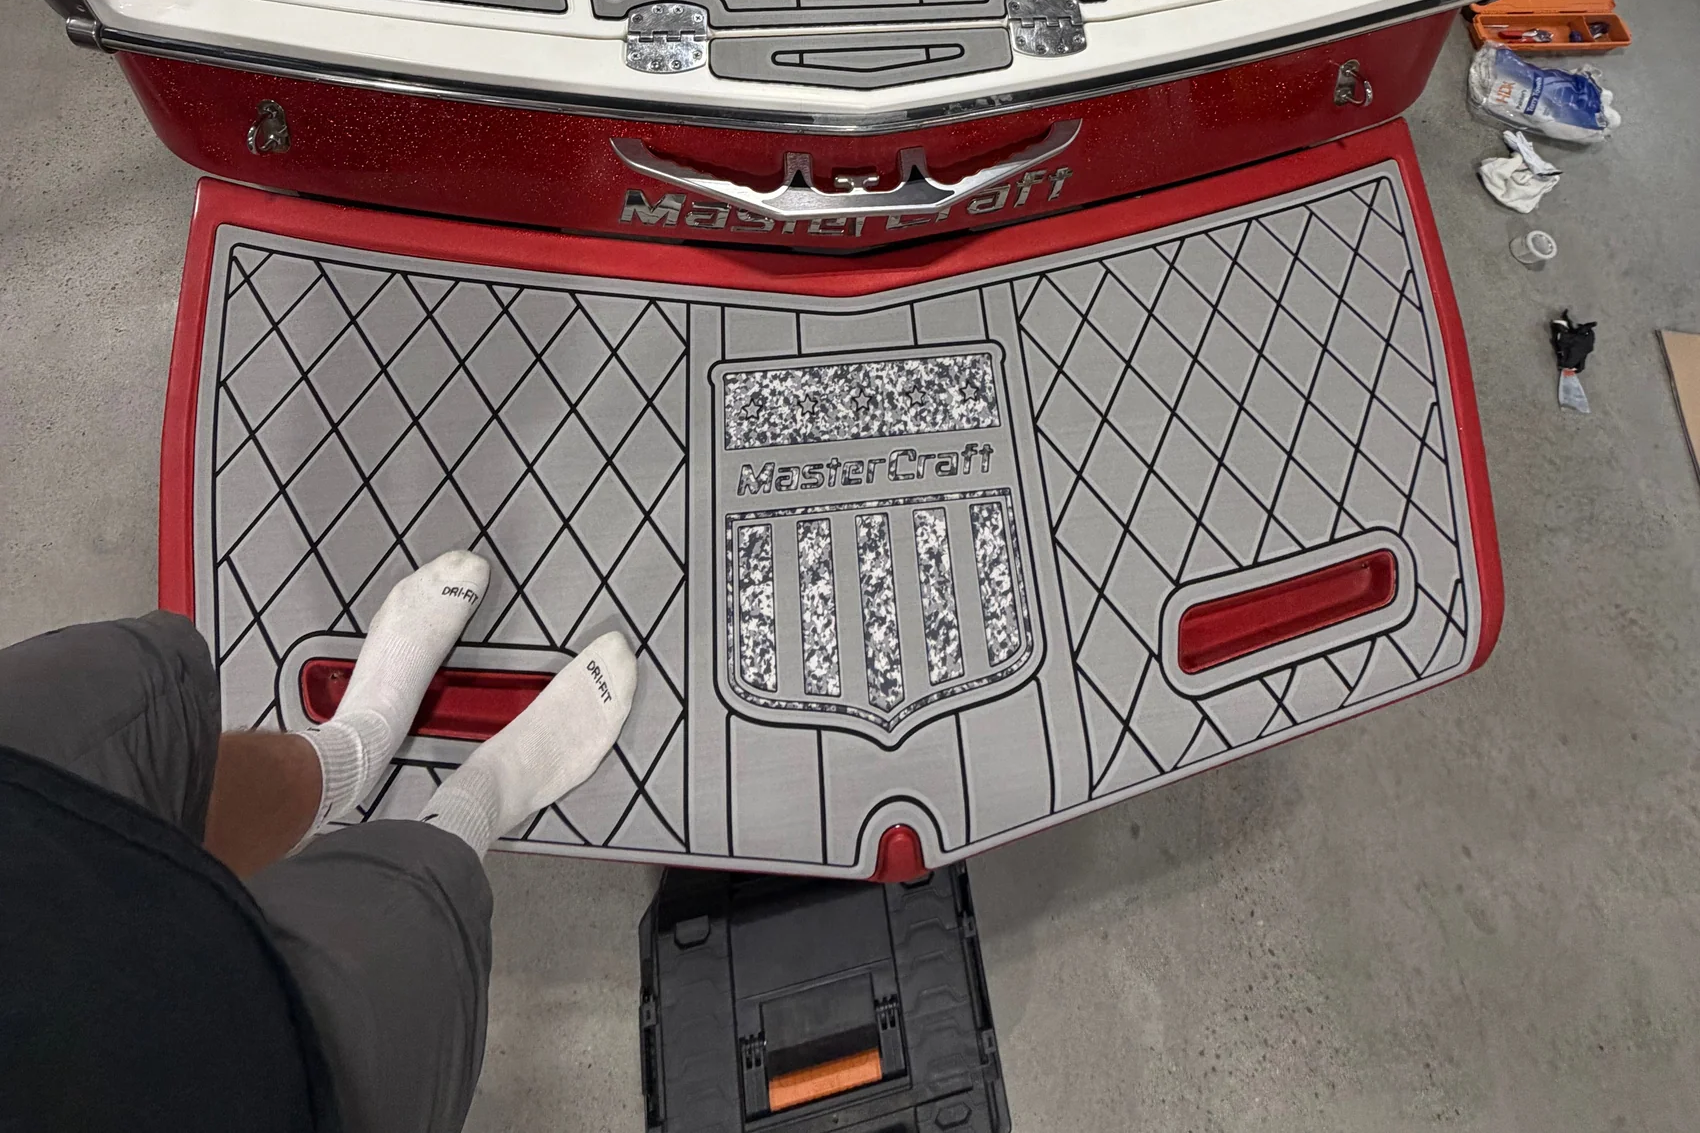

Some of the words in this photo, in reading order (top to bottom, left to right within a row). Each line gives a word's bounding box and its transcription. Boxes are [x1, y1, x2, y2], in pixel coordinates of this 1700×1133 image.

[1526, 94, 1539, 113] Terry
[736, 443, 994, 496] MasterCraft
[441, 586, 479, 606] DRI-FIT
[586, 660, 612, 704] DRI-FIT
